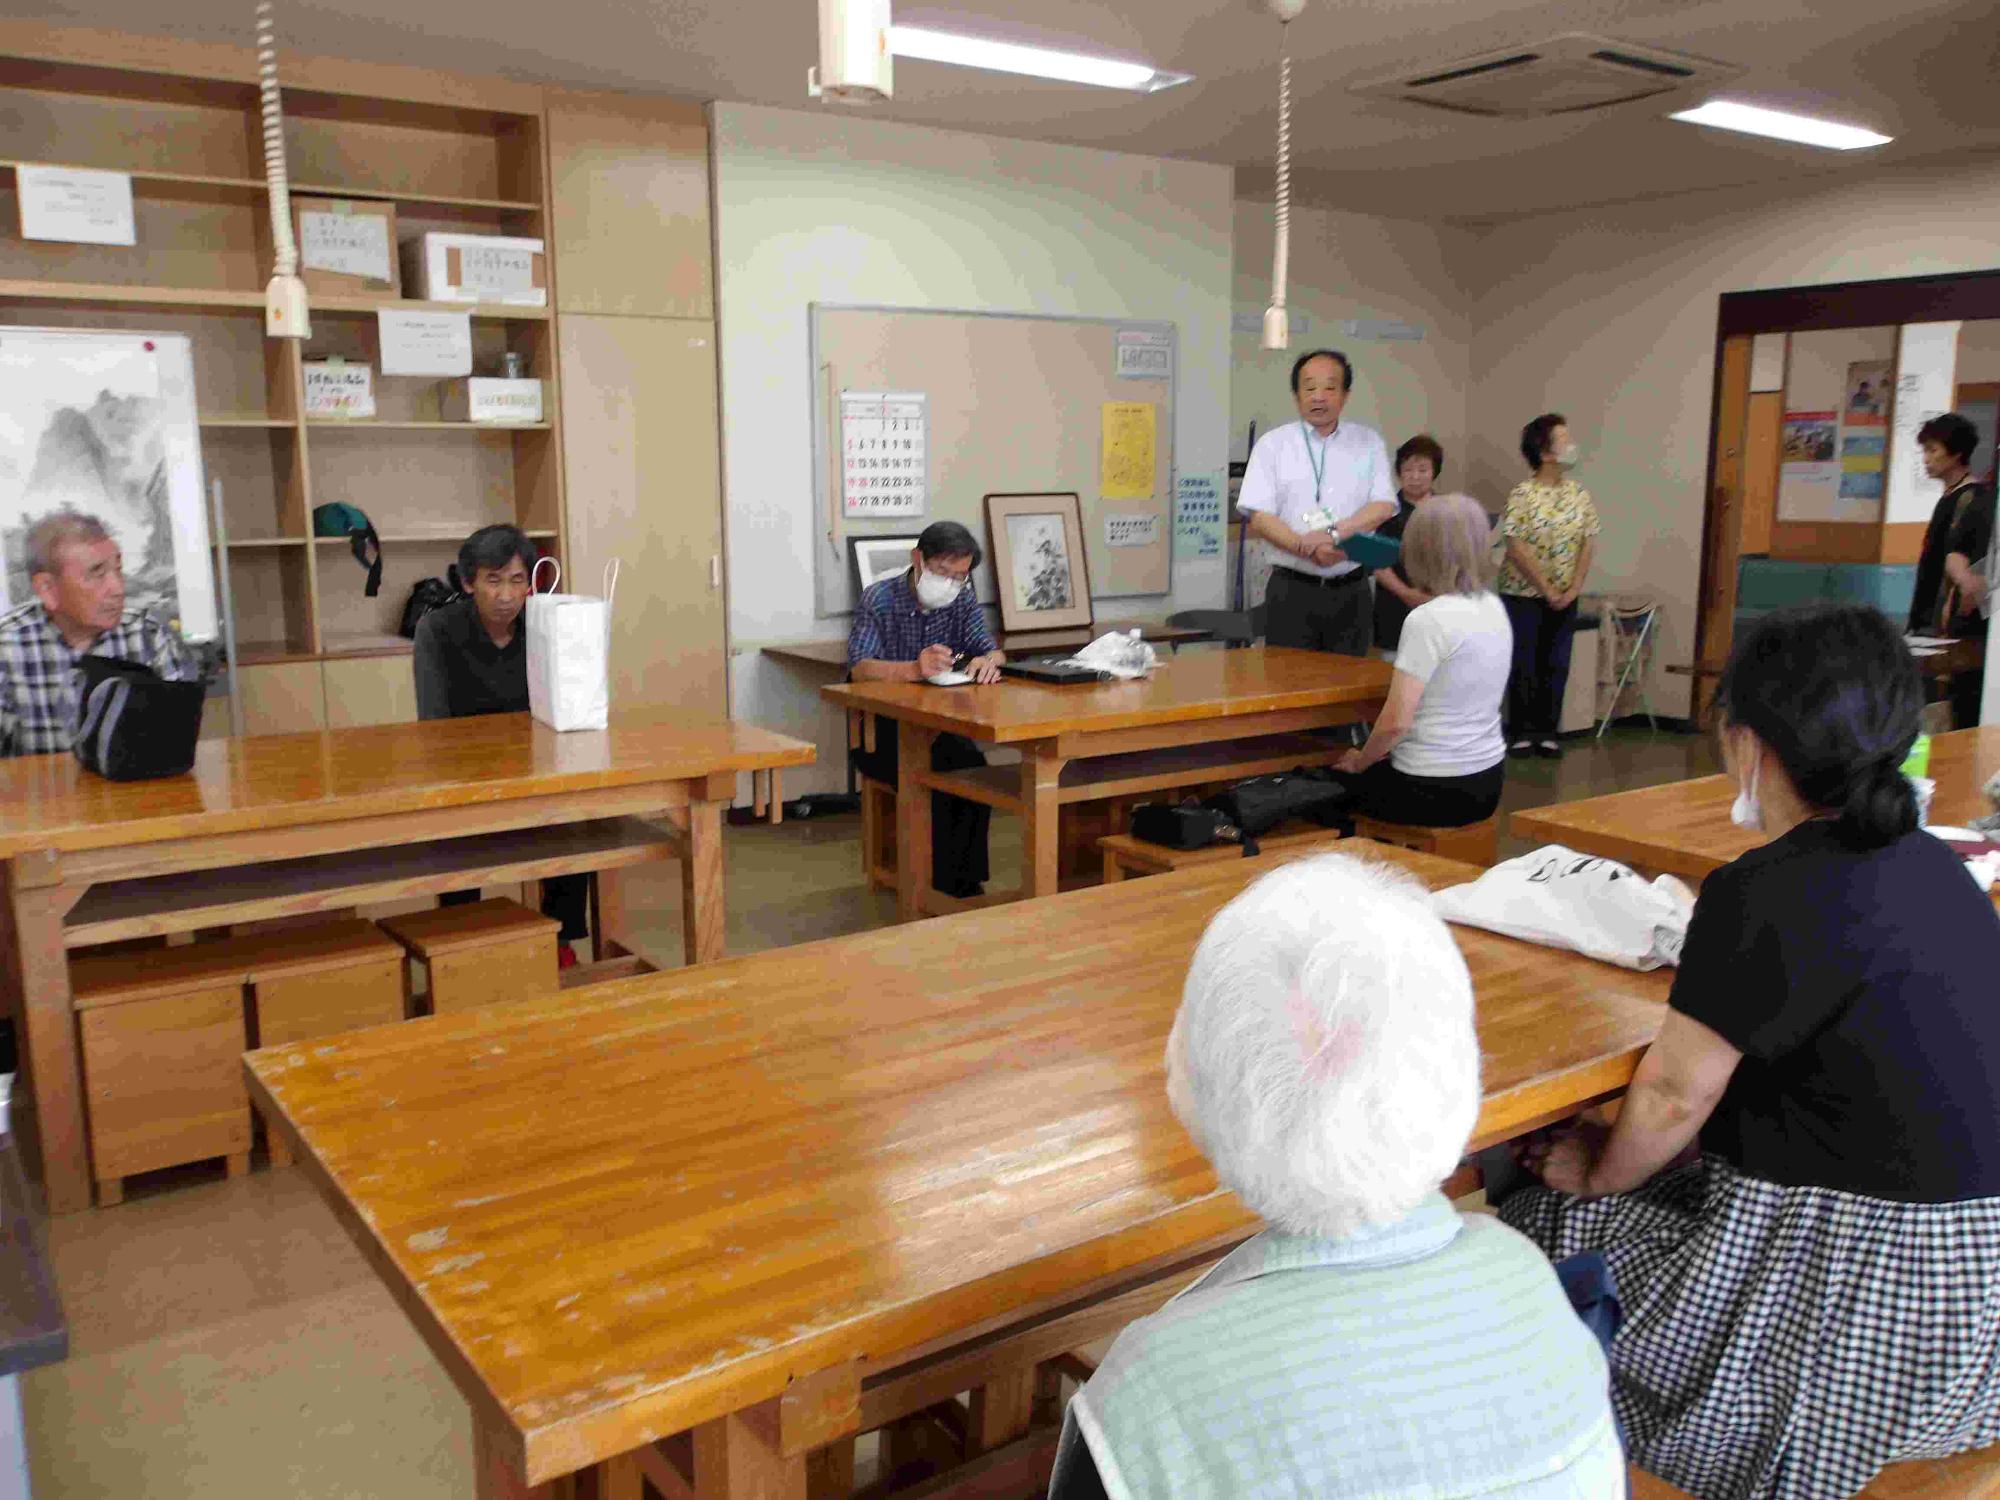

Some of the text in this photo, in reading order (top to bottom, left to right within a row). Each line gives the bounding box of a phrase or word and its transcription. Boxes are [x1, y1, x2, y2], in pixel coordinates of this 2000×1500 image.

[882, 439, 886, 450] 8
[903, 439, 911, 450] 10
[858, 458, 867, 468] 13
[869, 458, 878, 468] 14
[881, 458, 889, 468] 15
[893, 458, 901, 468] 16
[903, 458, 911, 468] 17
[881, 476, 891, 488] 22
[892, 476, 902, 488] 23
[903, 476, 912, 488] 24
[859, 494, 868, 506] 27
[871, 494, 879, 506] 28
[881, 494, 890, 506] 29
[892, 494, 902, 506] 30
[904, 494, 912, 506] 31
